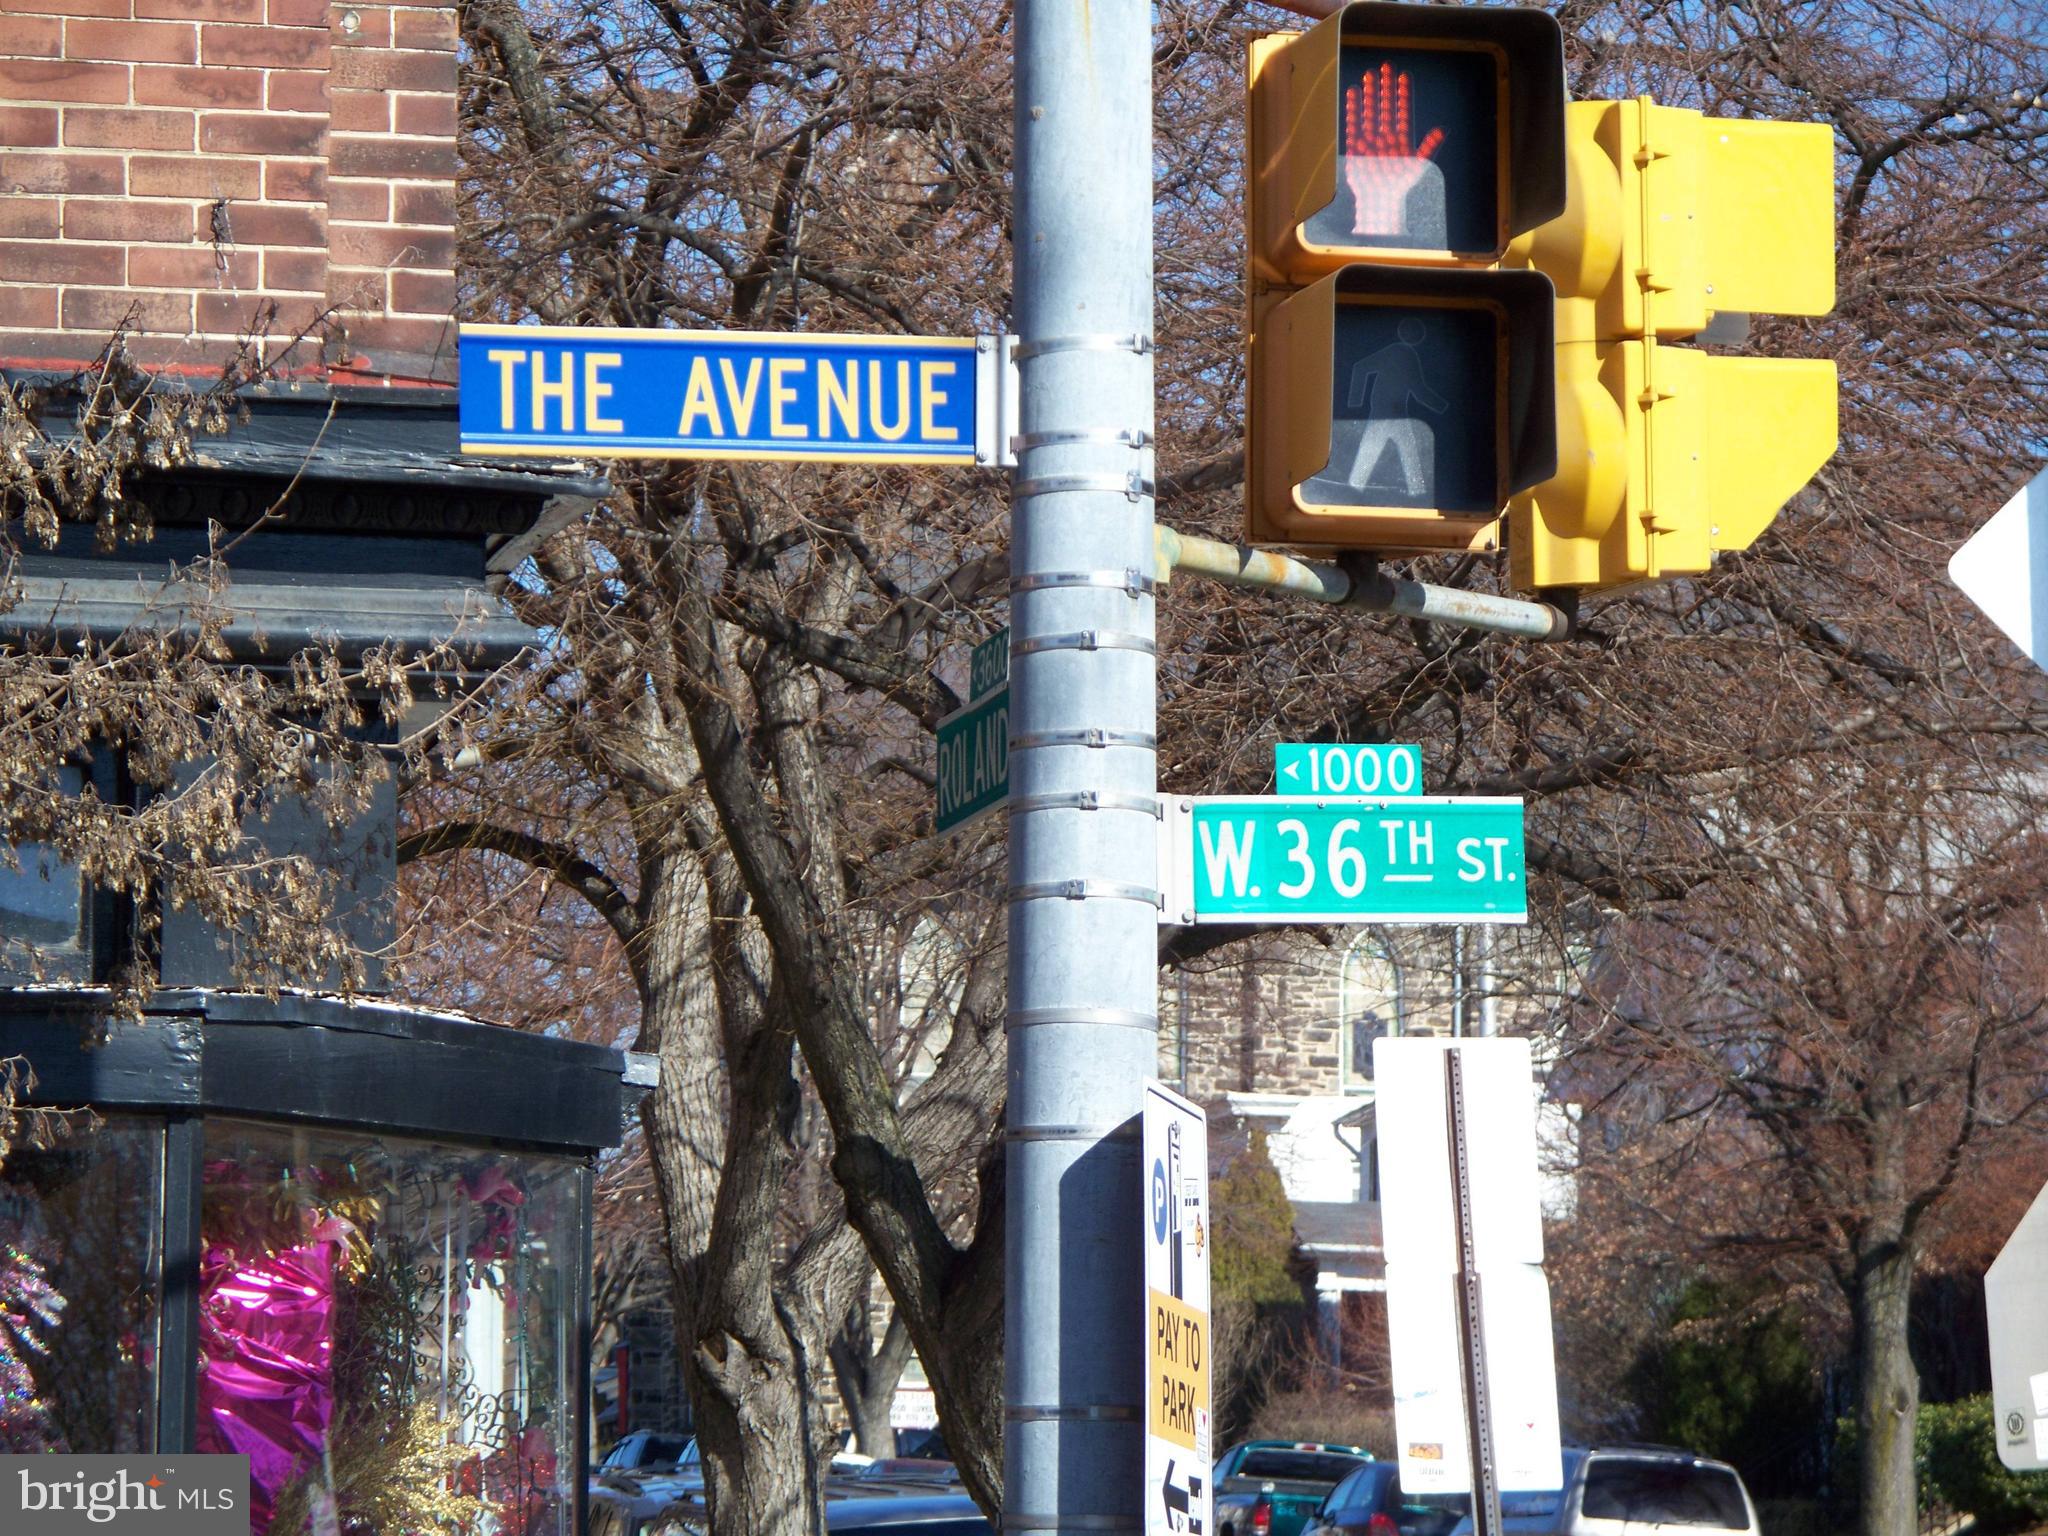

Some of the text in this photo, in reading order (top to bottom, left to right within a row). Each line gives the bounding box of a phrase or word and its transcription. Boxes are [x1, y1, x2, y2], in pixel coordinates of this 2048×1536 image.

[488, 349, 958, 441] THE AVENUE
[939, 707, 1008, 817] ROLAND
[1308, 748, 1415, 793] 1000
[1198, 819, 1261, 898] W.
[1456, 837, 1516, 882] ST.
[1155, 1176, 1164, 1223] P
[1157, 1306, 1200, 1372] PAY TO
[1162, 1375, 1196, 1436] PARK
